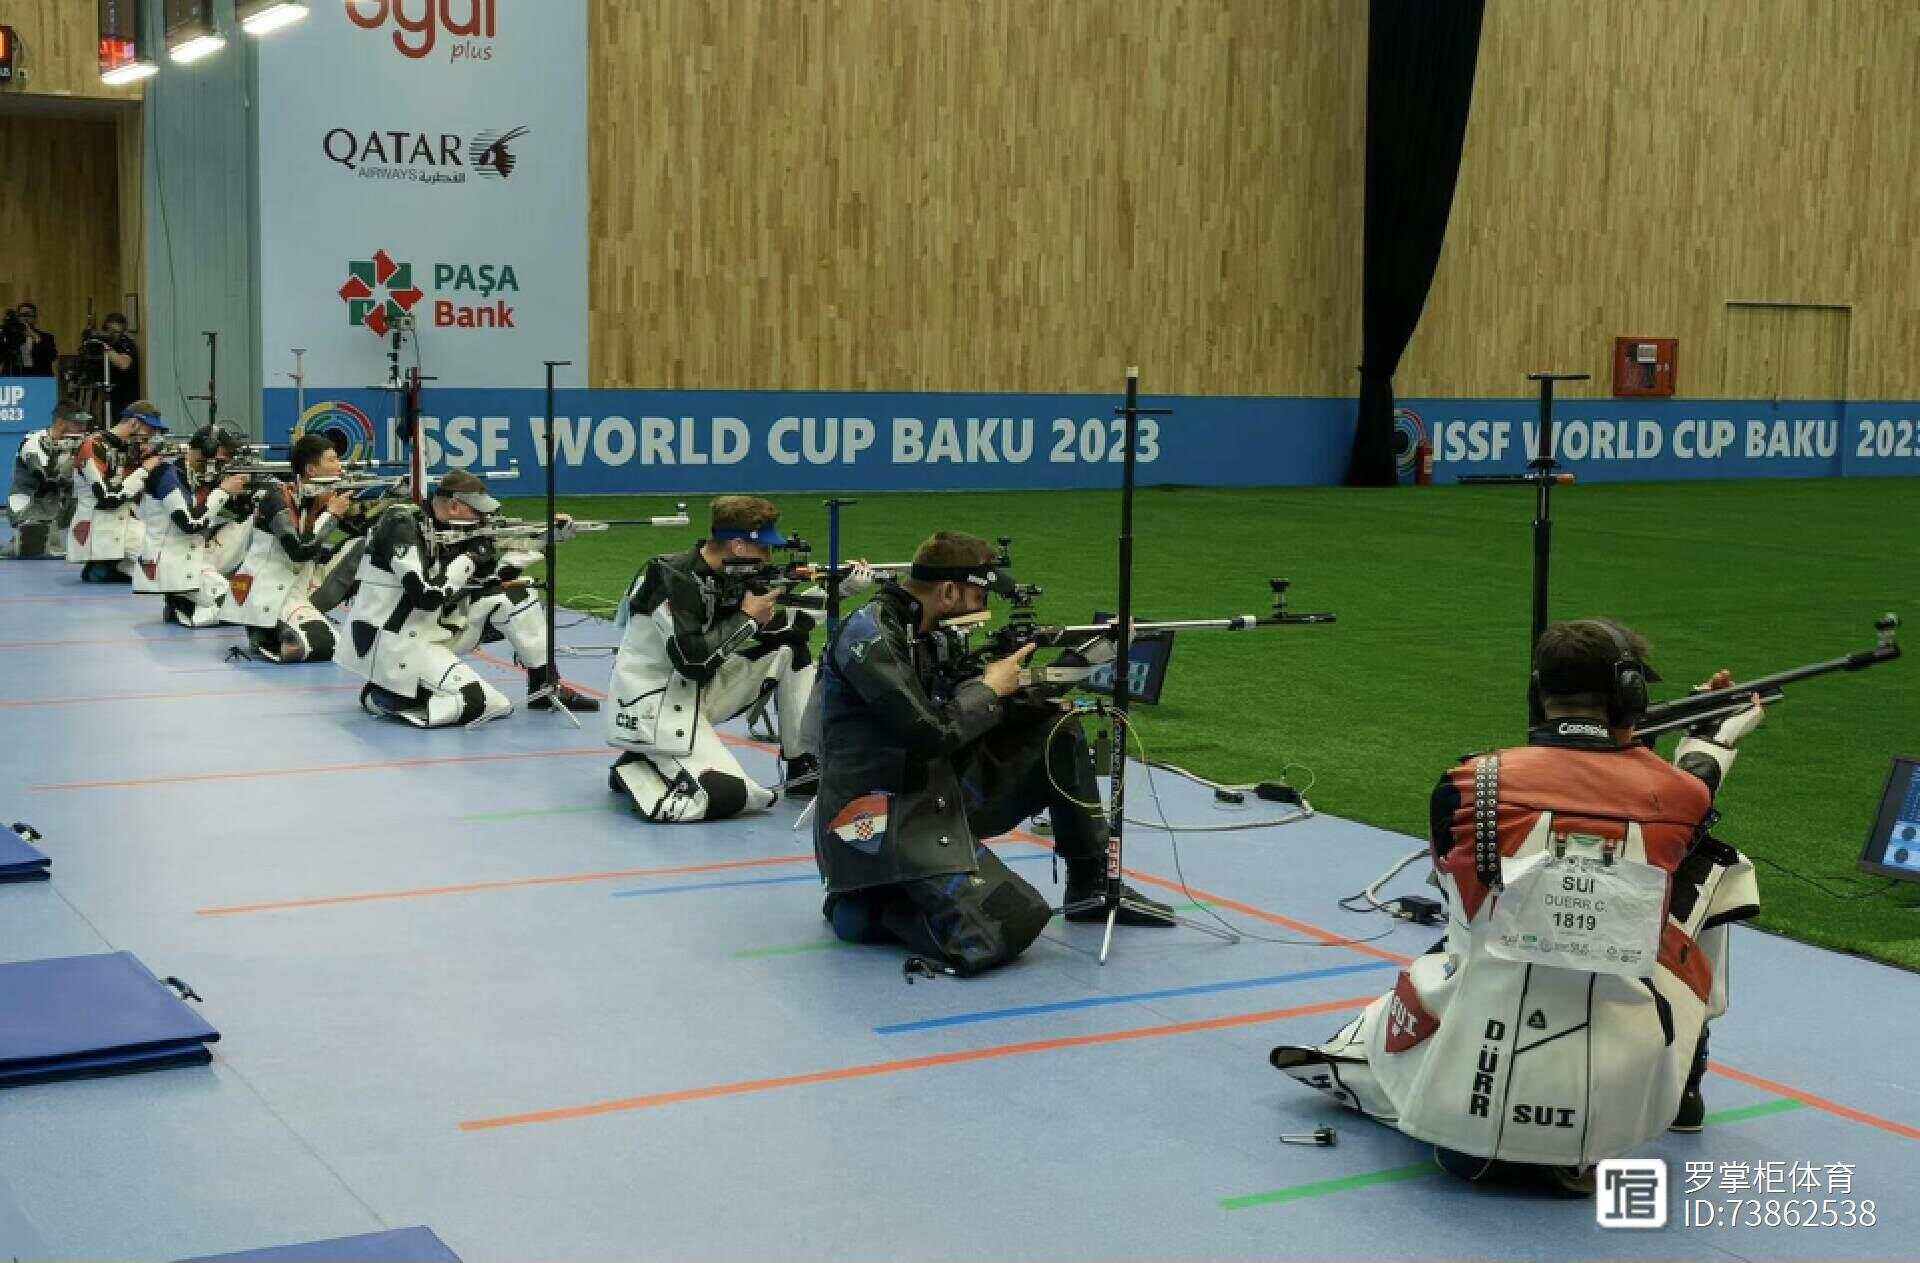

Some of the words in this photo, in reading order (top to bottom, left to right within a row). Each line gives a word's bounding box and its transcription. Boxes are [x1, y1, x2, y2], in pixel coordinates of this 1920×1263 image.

[450, 40, 493, 64] plus
[322, 128, 463, 169] QATAR
[358, 166, 417, 180] AIRWAYS
[434, 263, 520, 298] PAŞA
[434, 300, 516, 328] Bank
[529, 416, 750, 465] WORLD
[767, 417, 876, 464] CUP
[892, 418, 1034, 463] BAKU
[1050, 418, 1160, 463] 2023
[1432, 420, 1512, 461] ISSF
[1522, 419, 1663, 460] WORLD
[1672, 420, 1736, 459] CUP
[1745, 420, 1840, 457] BAKU
[1562, 876, 1596, 894] SUI
[1544, 894, 1592, 911] DUERR
[1553, 912, 1596, 931] 1819
[1469, 1019, 1505, 1118] DÜRR
[1512, 1104, 1576, 1129] SUI
